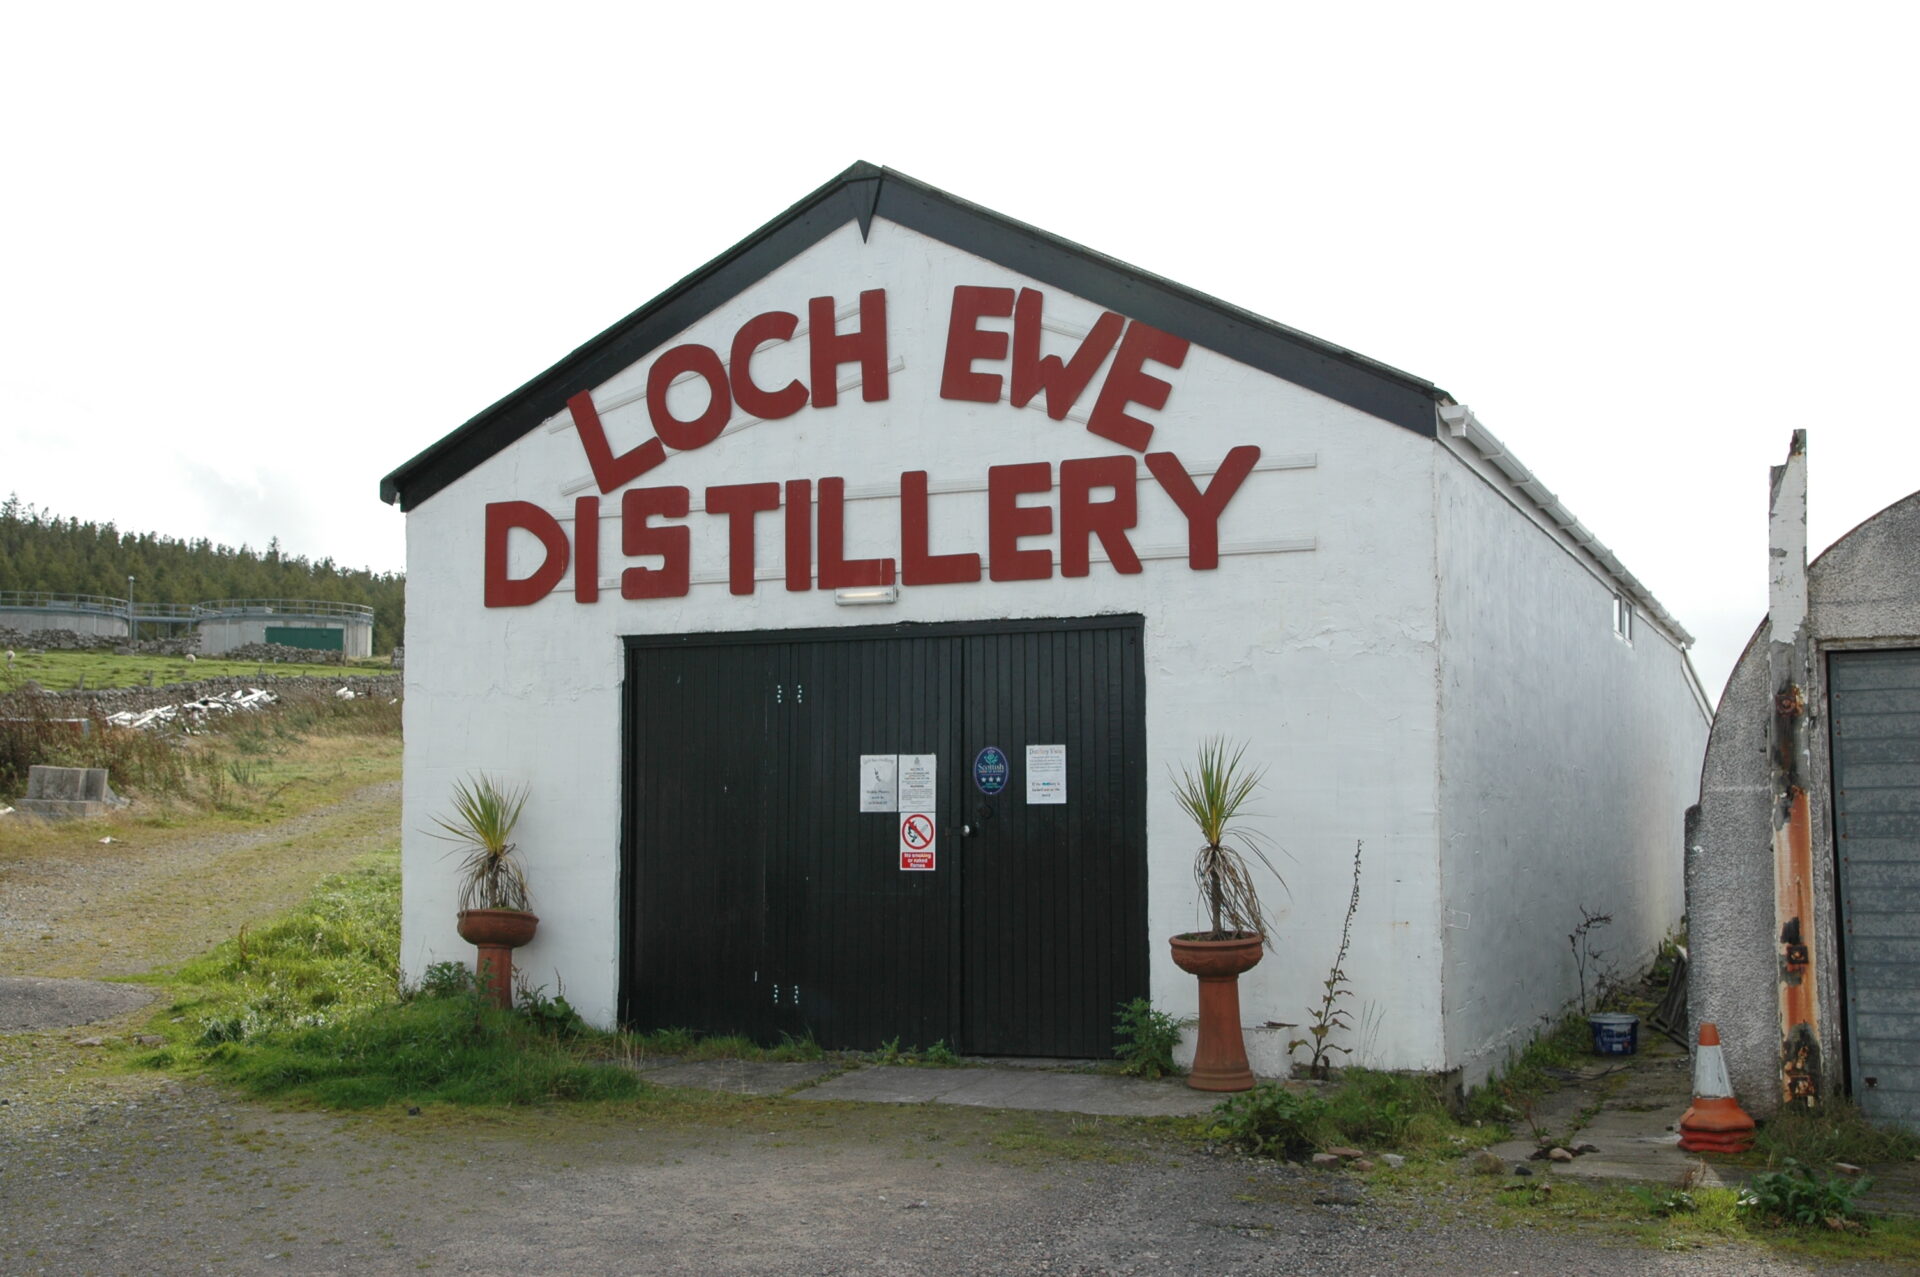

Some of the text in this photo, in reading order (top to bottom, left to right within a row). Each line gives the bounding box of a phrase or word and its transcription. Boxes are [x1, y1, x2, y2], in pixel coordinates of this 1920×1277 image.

[567, 285, 1191, 494] LOCH EWE
[484, 445, 1261, 607] DISTILLERY
